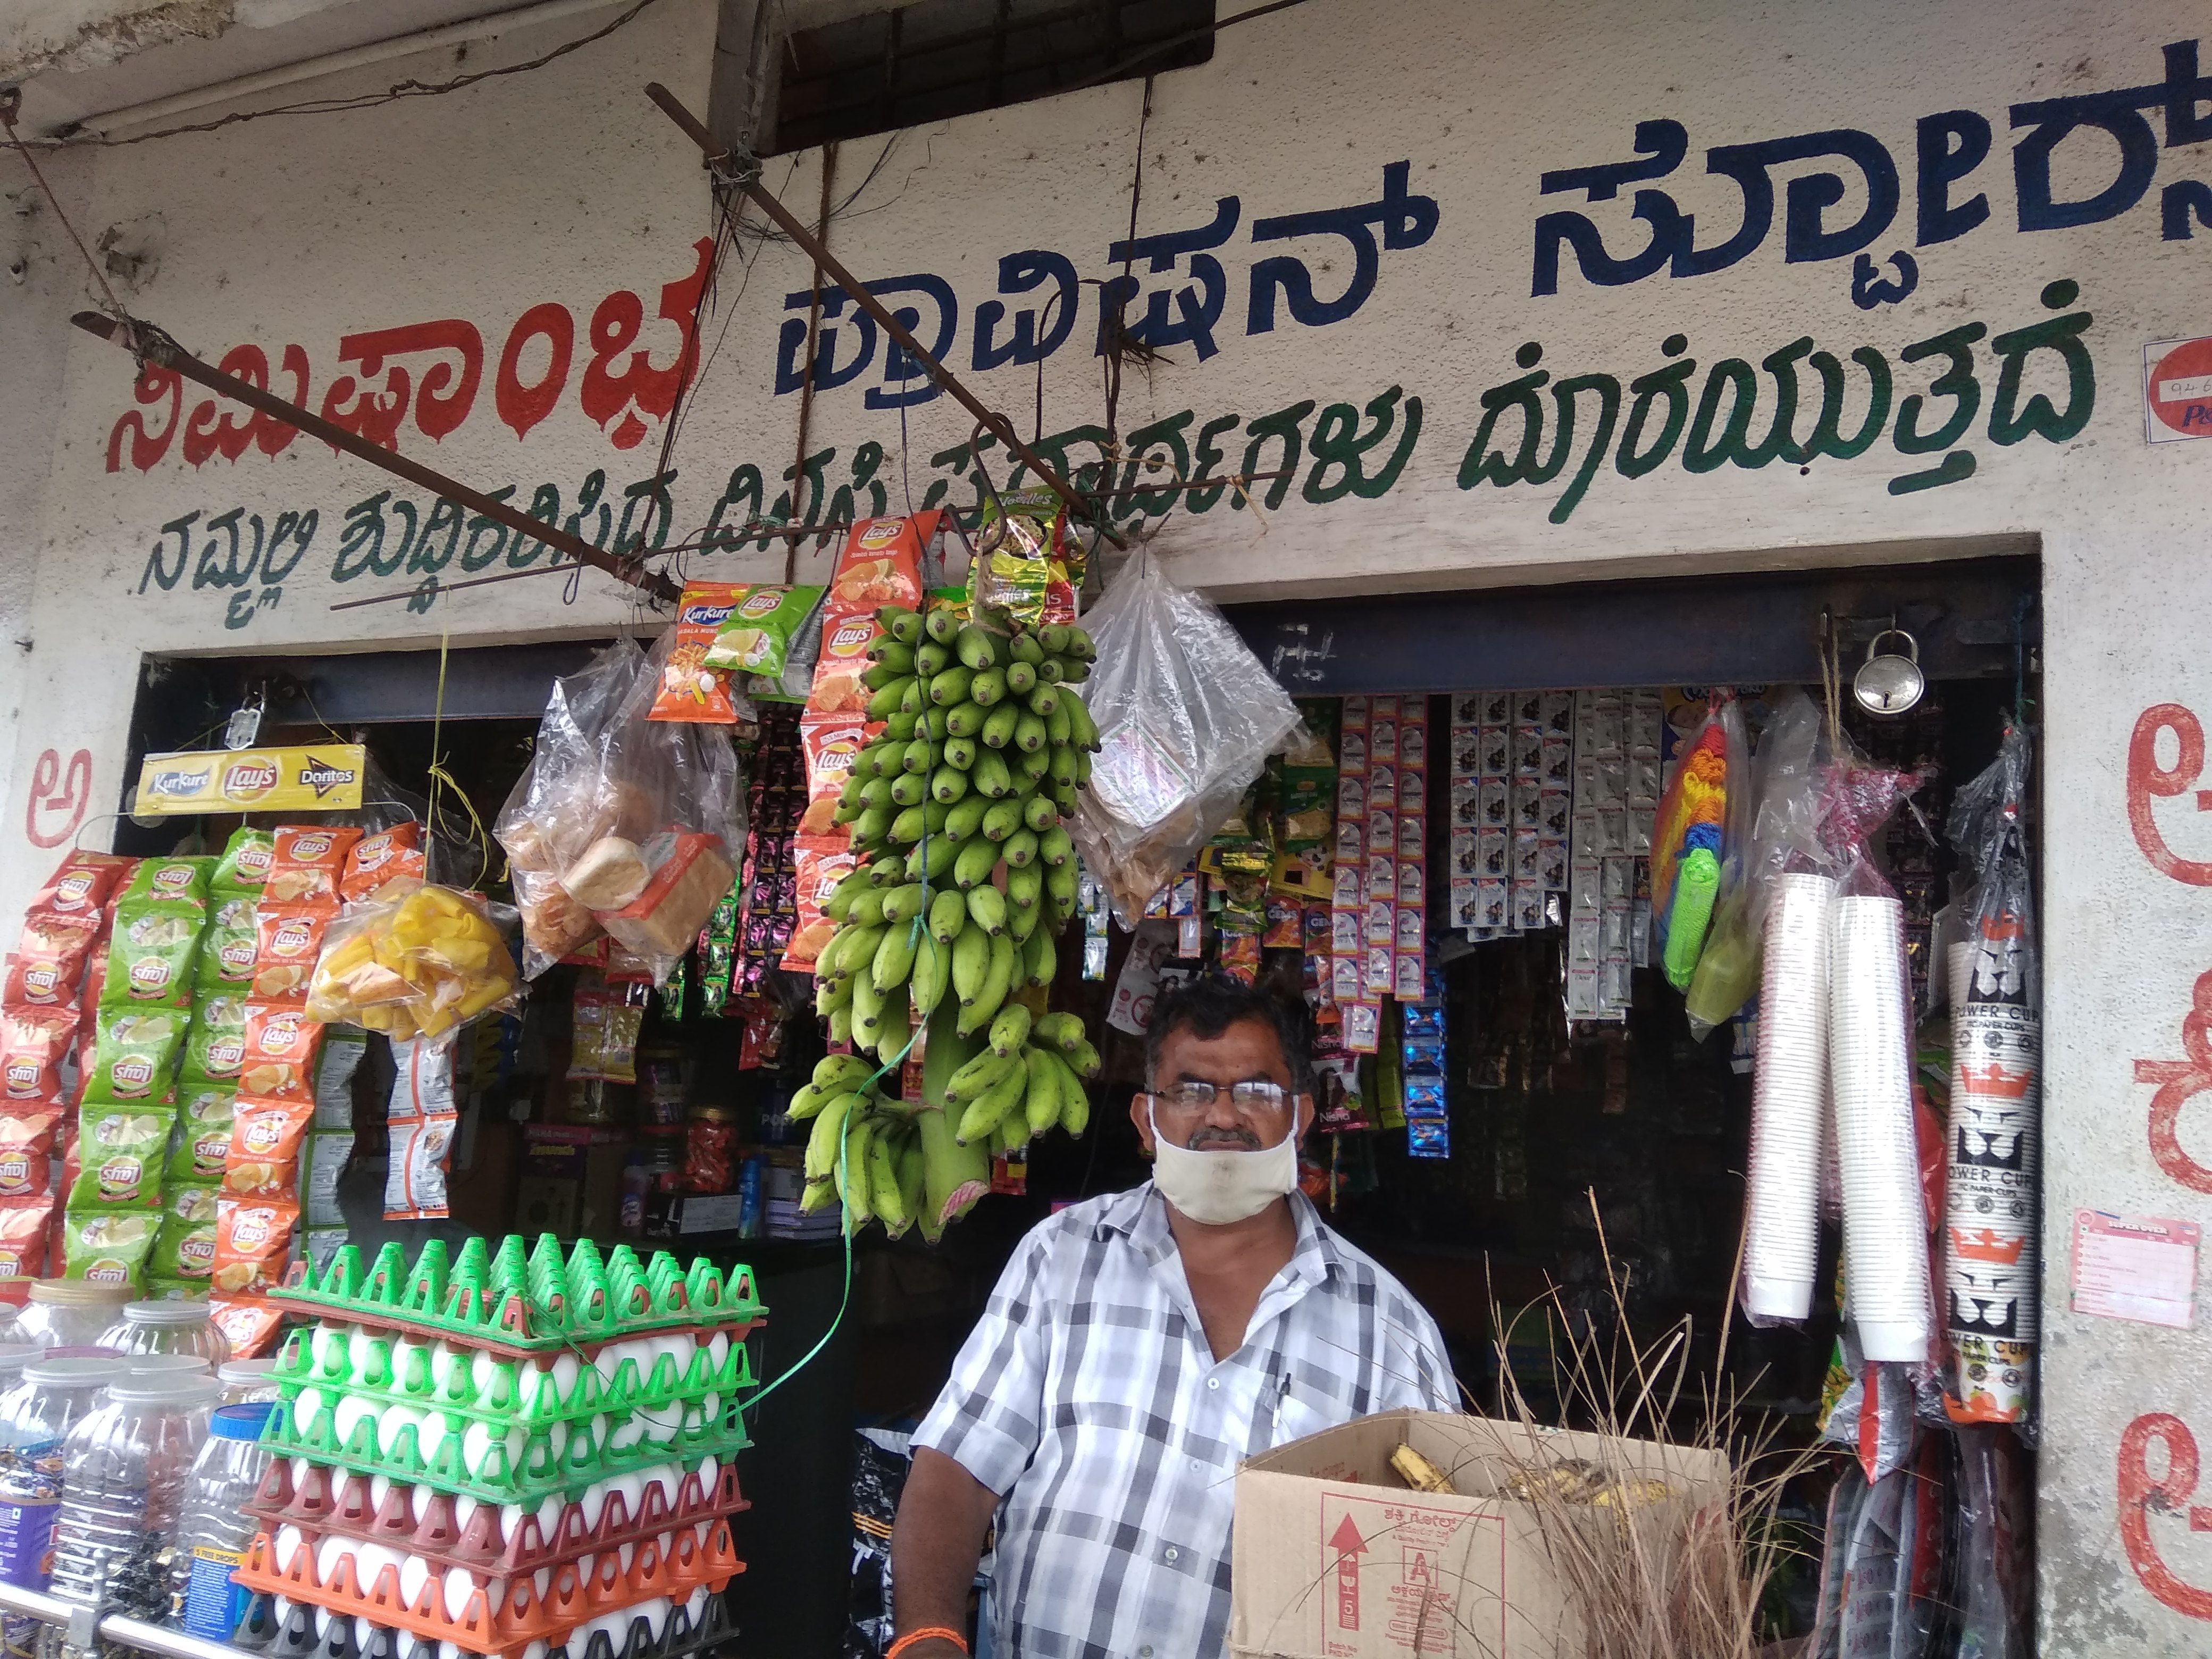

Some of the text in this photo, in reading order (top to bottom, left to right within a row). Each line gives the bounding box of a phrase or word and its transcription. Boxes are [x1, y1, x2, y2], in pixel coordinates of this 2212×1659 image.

[302, 769, 353, 784] Doritos
[2010, 1007, 2039, 1021] CUP
[1948, 1166, 1990, 1182] OWER
